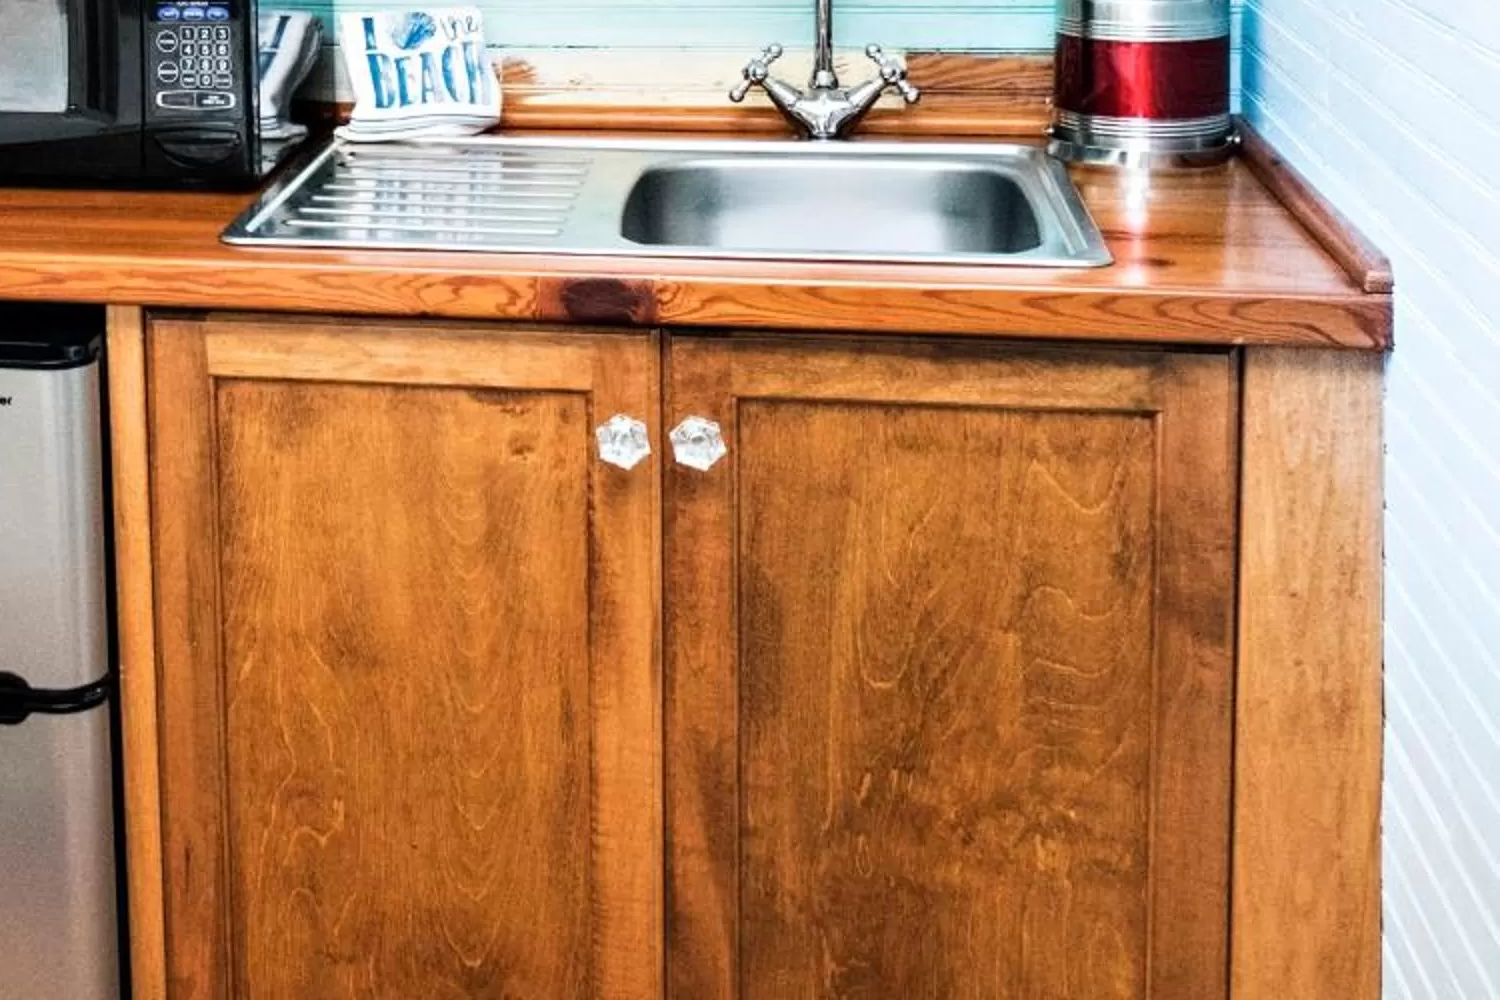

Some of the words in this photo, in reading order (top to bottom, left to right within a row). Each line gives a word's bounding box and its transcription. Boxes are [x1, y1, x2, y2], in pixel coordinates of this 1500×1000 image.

[201, 29, 209, 39] 2
[218, 29, 227, 39] 3
[184, 45, 192, 55] 4
[185, 59, 193, 70] 7
[365, 40, 491, 109] BEACH
[202, 75, 210, 85] 0
